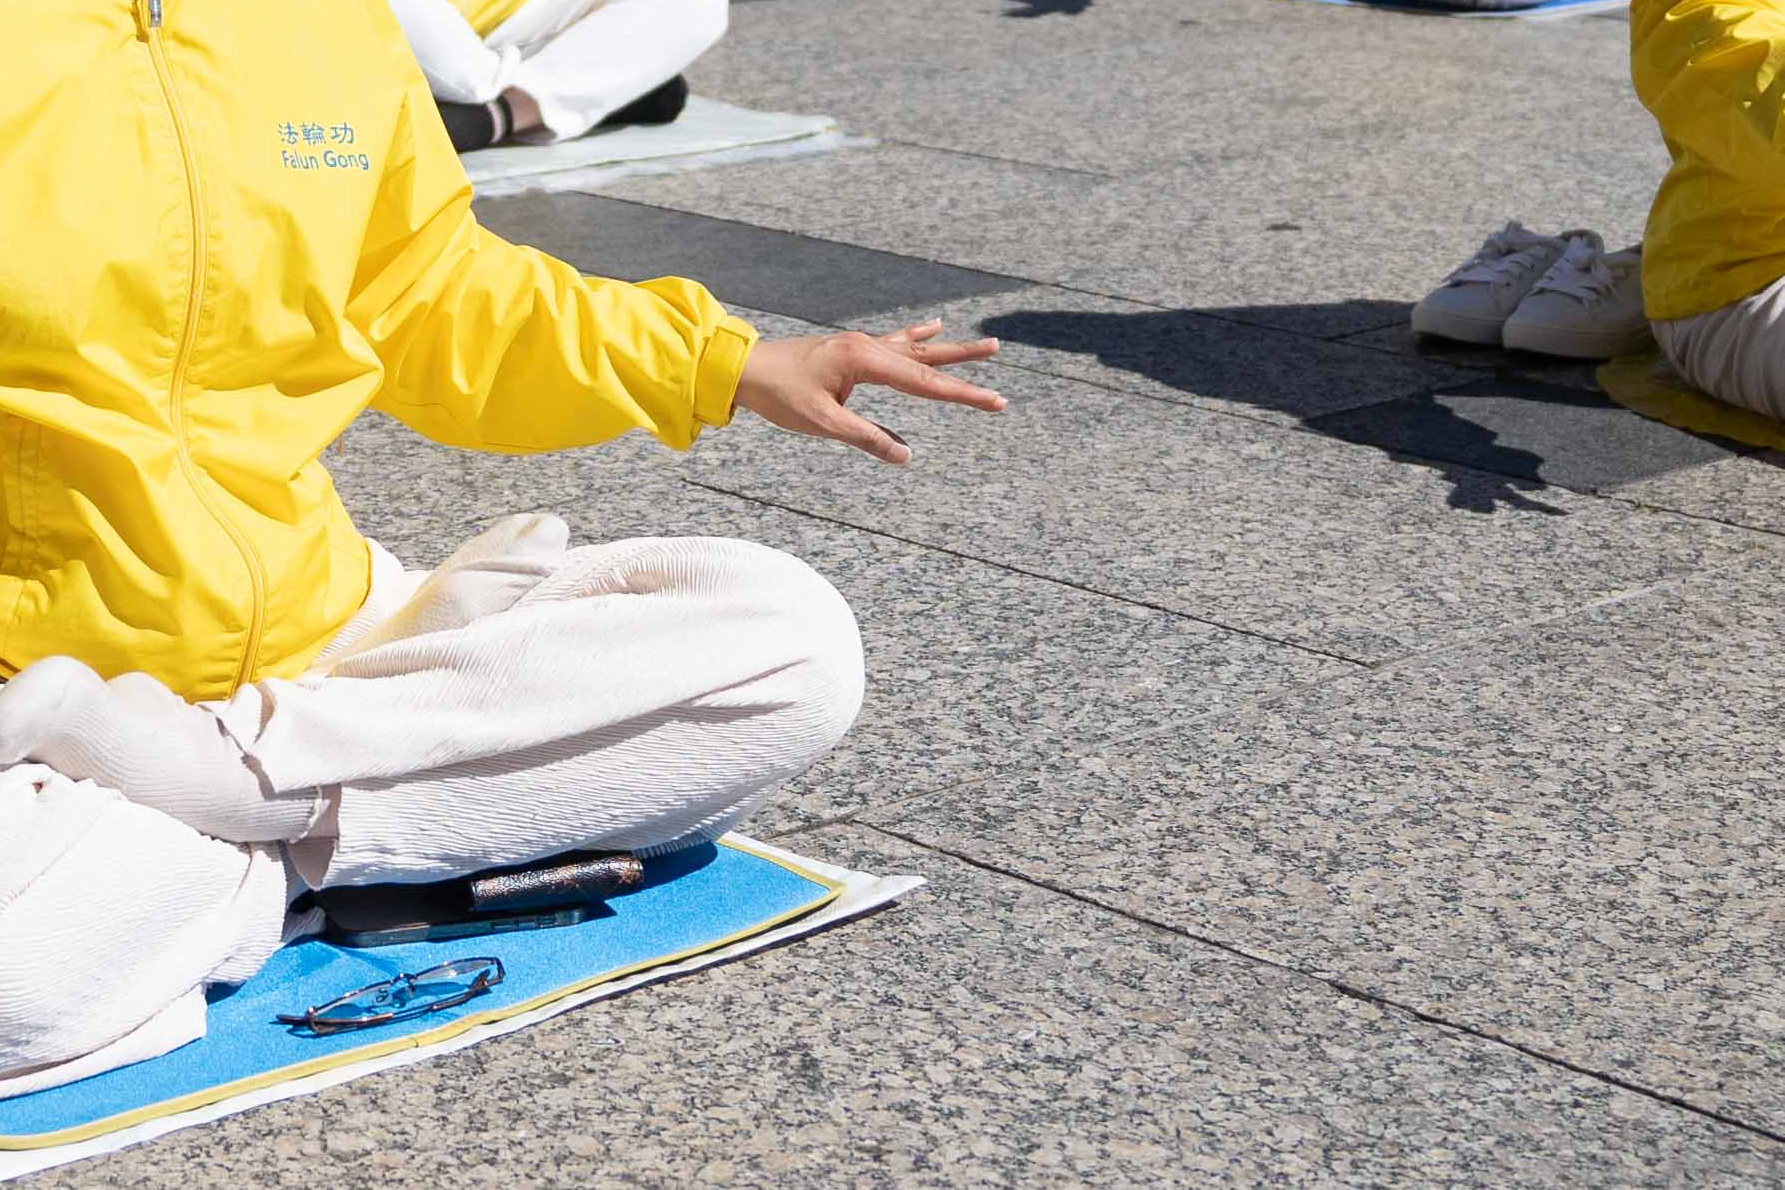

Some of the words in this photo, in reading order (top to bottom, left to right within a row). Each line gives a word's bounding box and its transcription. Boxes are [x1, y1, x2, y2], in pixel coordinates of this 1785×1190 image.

[277, 121, 355, 146] 法輪功
[281, 150, 320, 171] Falun
[323, 150, 369, 171] Gong
